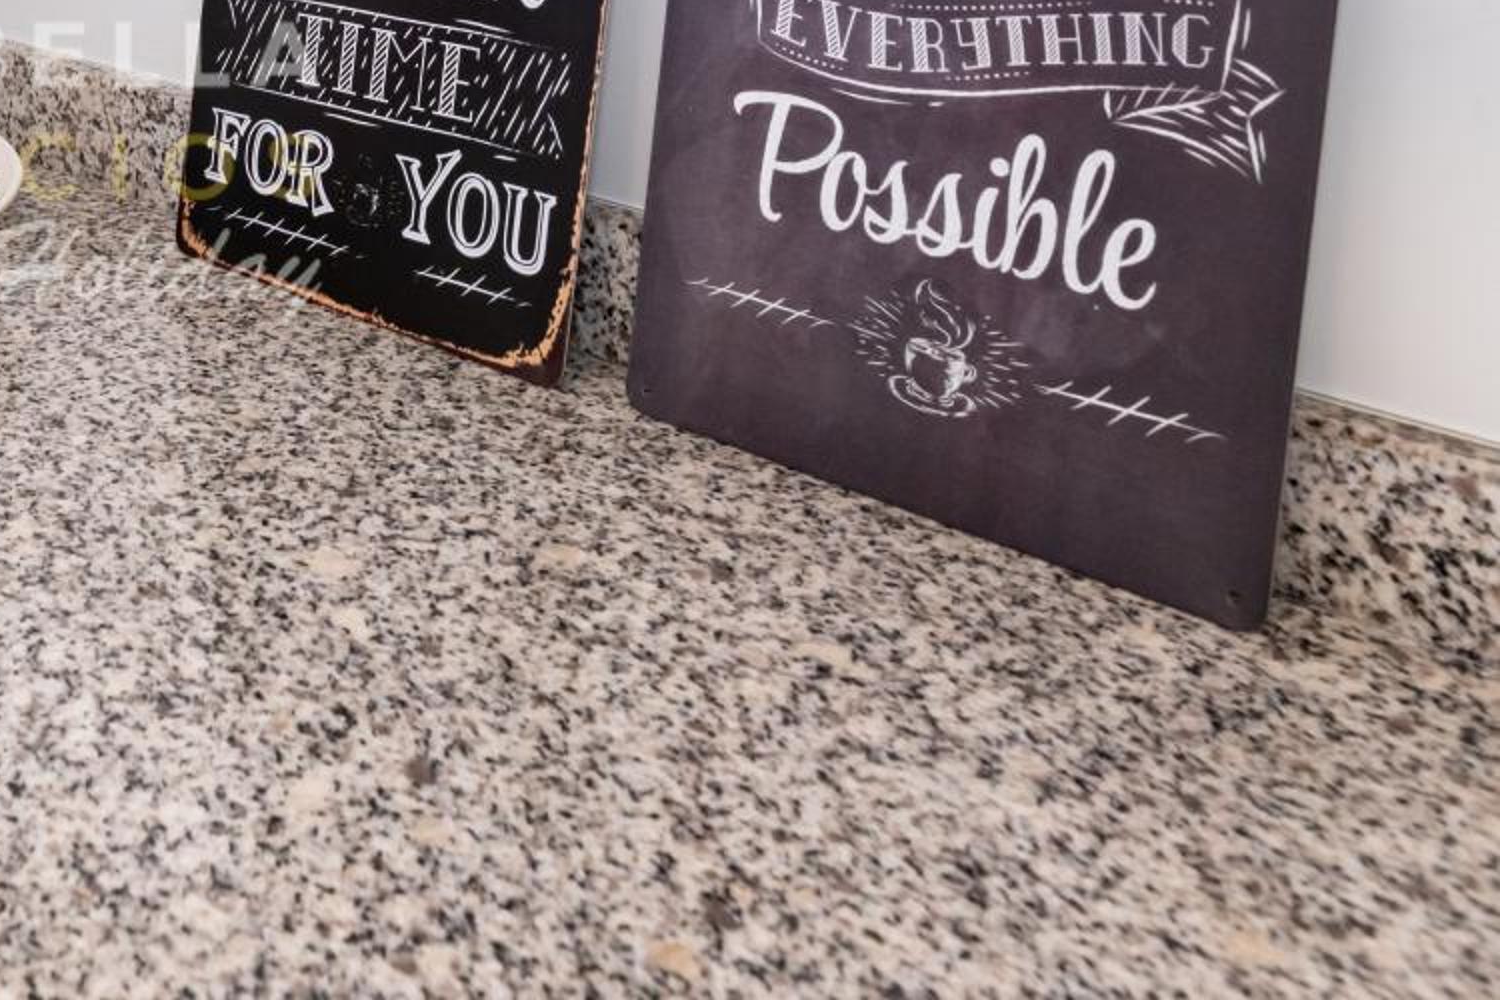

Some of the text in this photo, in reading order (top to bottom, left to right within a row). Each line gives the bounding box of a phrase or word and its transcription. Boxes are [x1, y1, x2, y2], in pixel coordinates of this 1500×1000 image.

[296, 12, 481, 123] TIME
[203, 106, 558, 276] FOR YOU
[733, 90, 1158, 311] Possible
